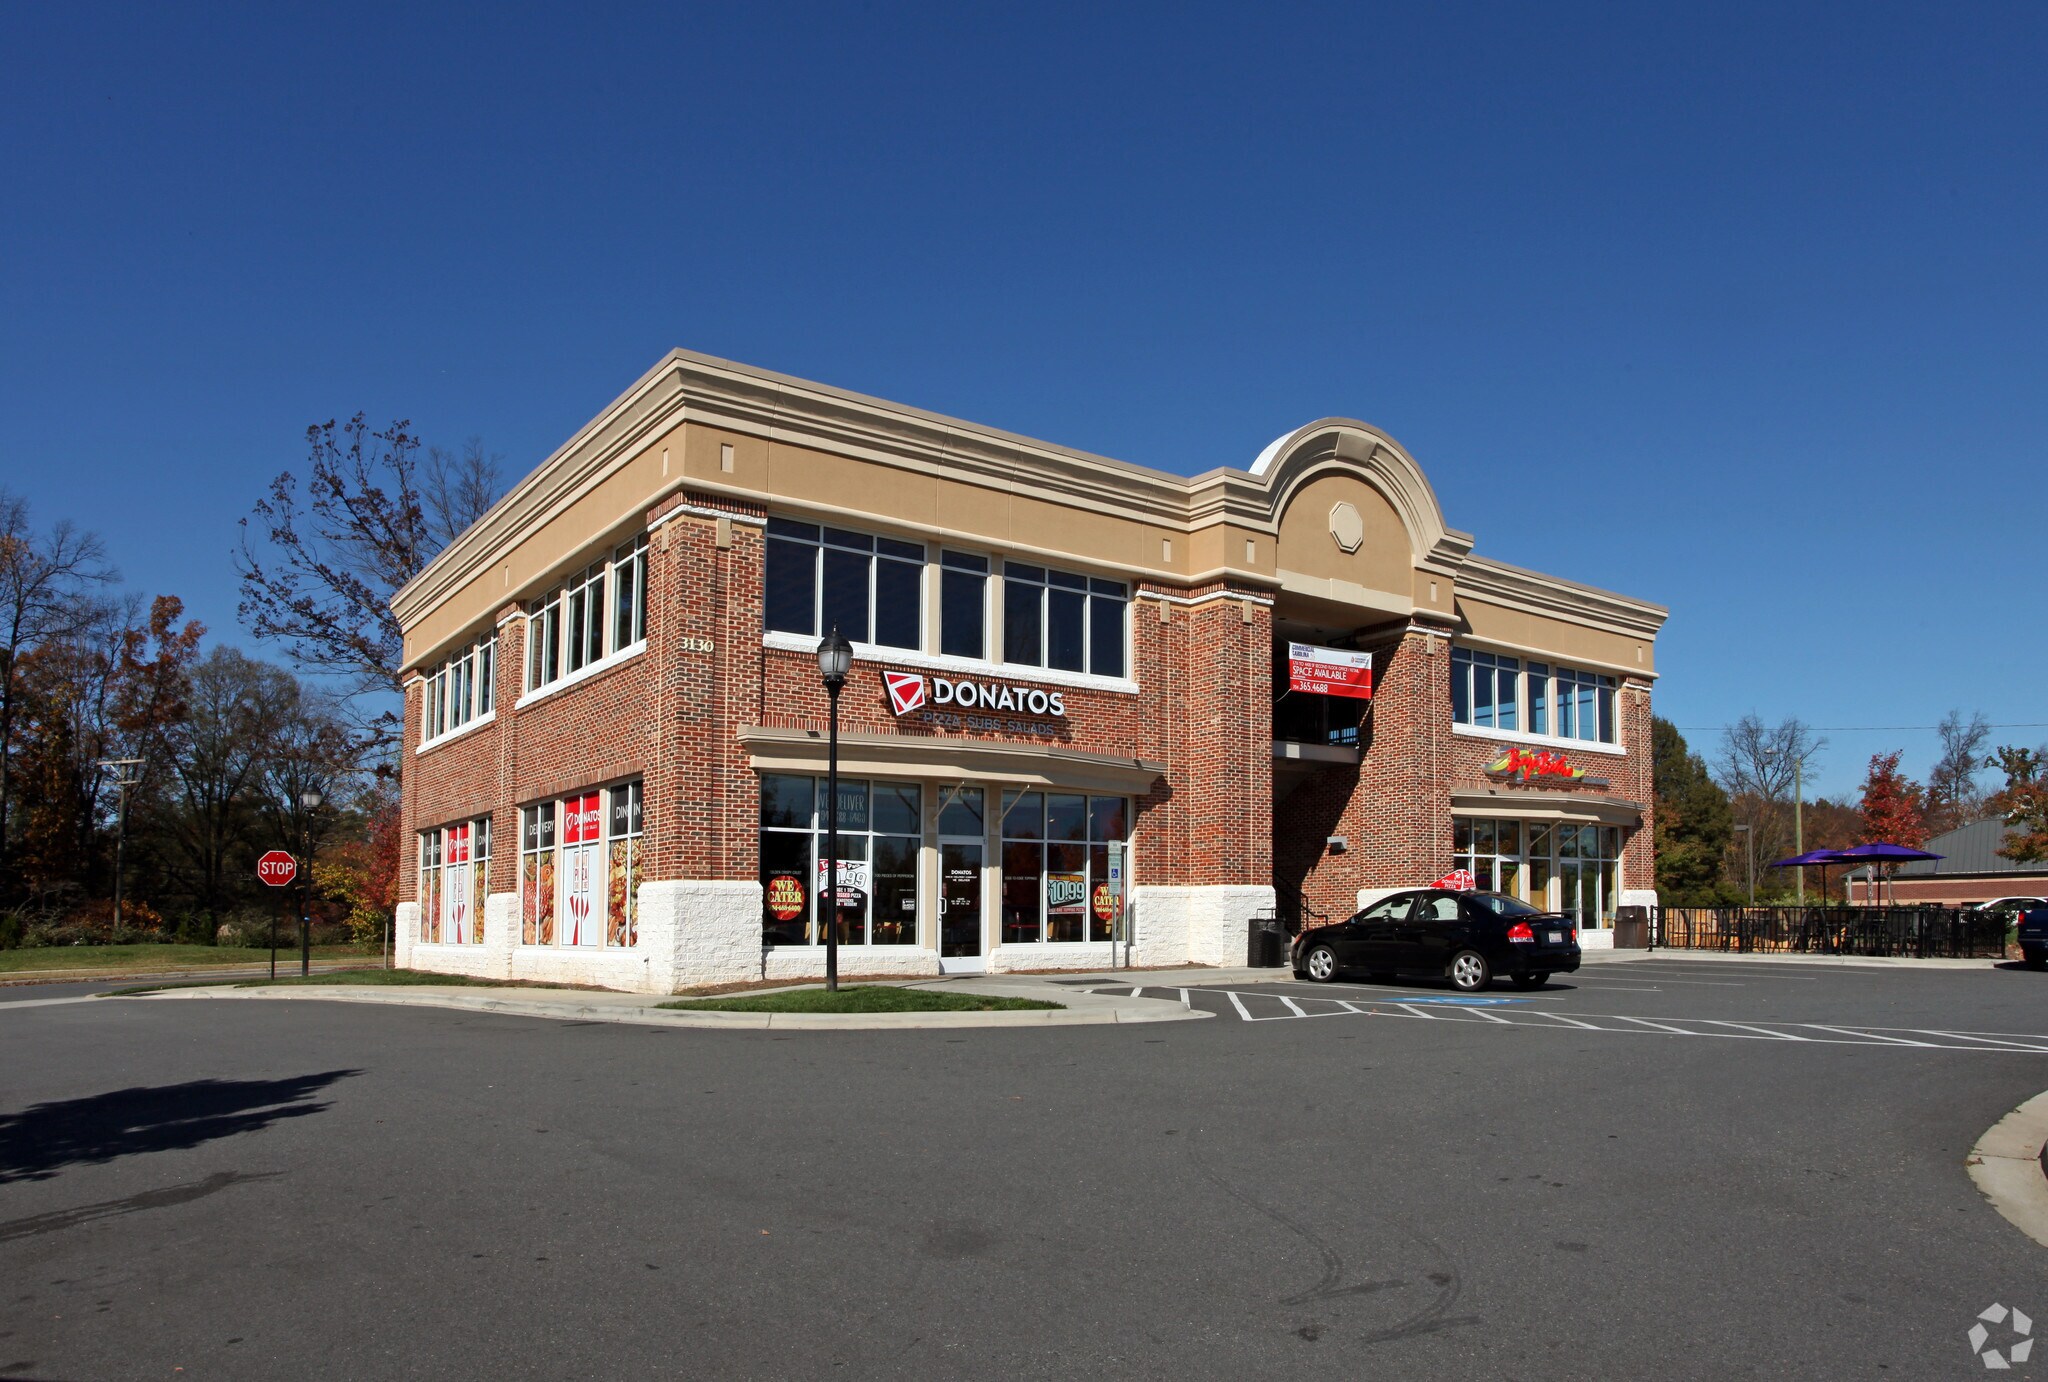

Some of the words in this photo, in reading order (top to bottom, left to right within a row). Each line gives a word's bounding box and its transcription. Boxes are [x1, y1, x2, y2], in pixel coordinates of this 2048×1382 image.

[680, 637, 714, 652] 3130
[1292, 665, 1312, 676] SPACE
[1314, 669, 1347, 680] AVAILABLE
[1300, 681, 1328, 693] 365.4688
[930, 677, 1066, 716] DONATOS
[923, 712, 960, 726] PIZZA
[967, 716, 1001, 730] SUBS
[1007, 720, 1055, 735] SALADS
[261, 862, 294, 875] STOP
[775, 880, 794, 892] WE
[767, 891, 802, 903] CATER
